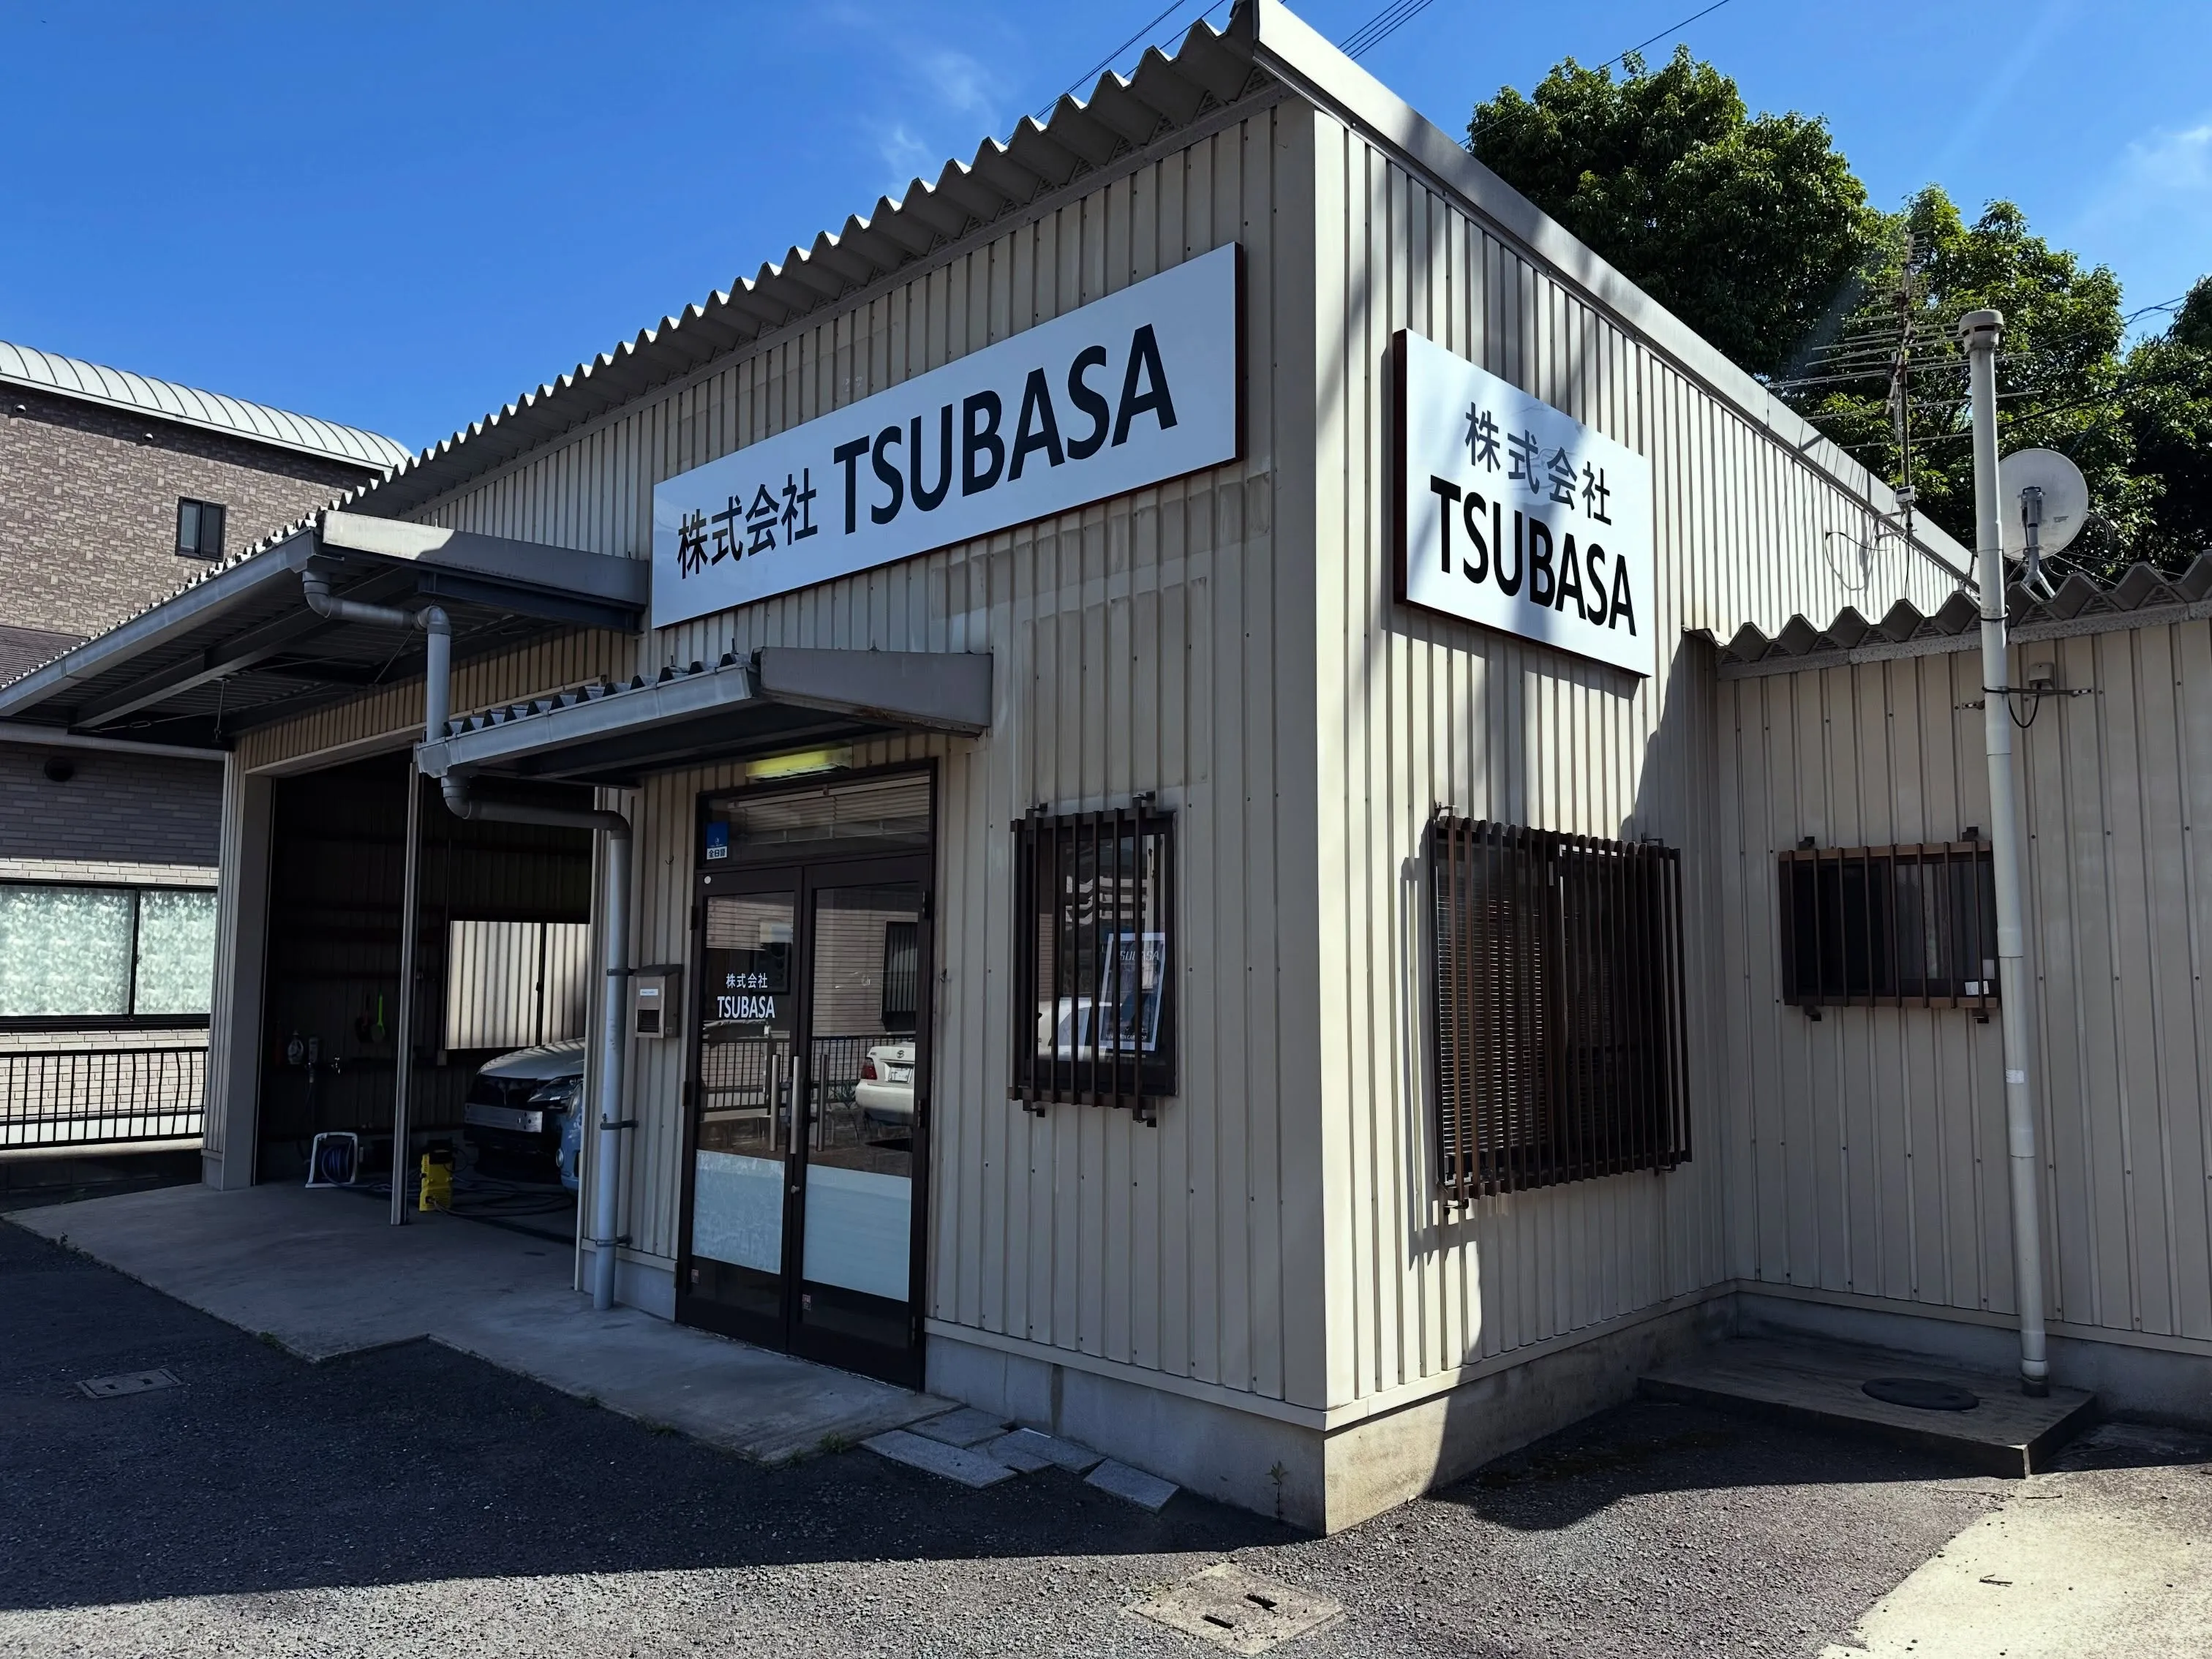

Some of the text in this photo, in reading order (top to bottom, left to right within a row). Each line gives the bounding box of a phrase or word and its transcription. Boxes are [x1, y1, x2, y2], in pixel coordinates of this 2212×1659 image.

[677, 323, 1178, 579] 株式会社 TSUBASA
[1465, 402, 1612, 526] 株式会社
[1430, 474, 1637, 636] TSUBASA
[718, 996, 775, 1019] TSUBASA
[726, 973, 768, 988] 株式会社
